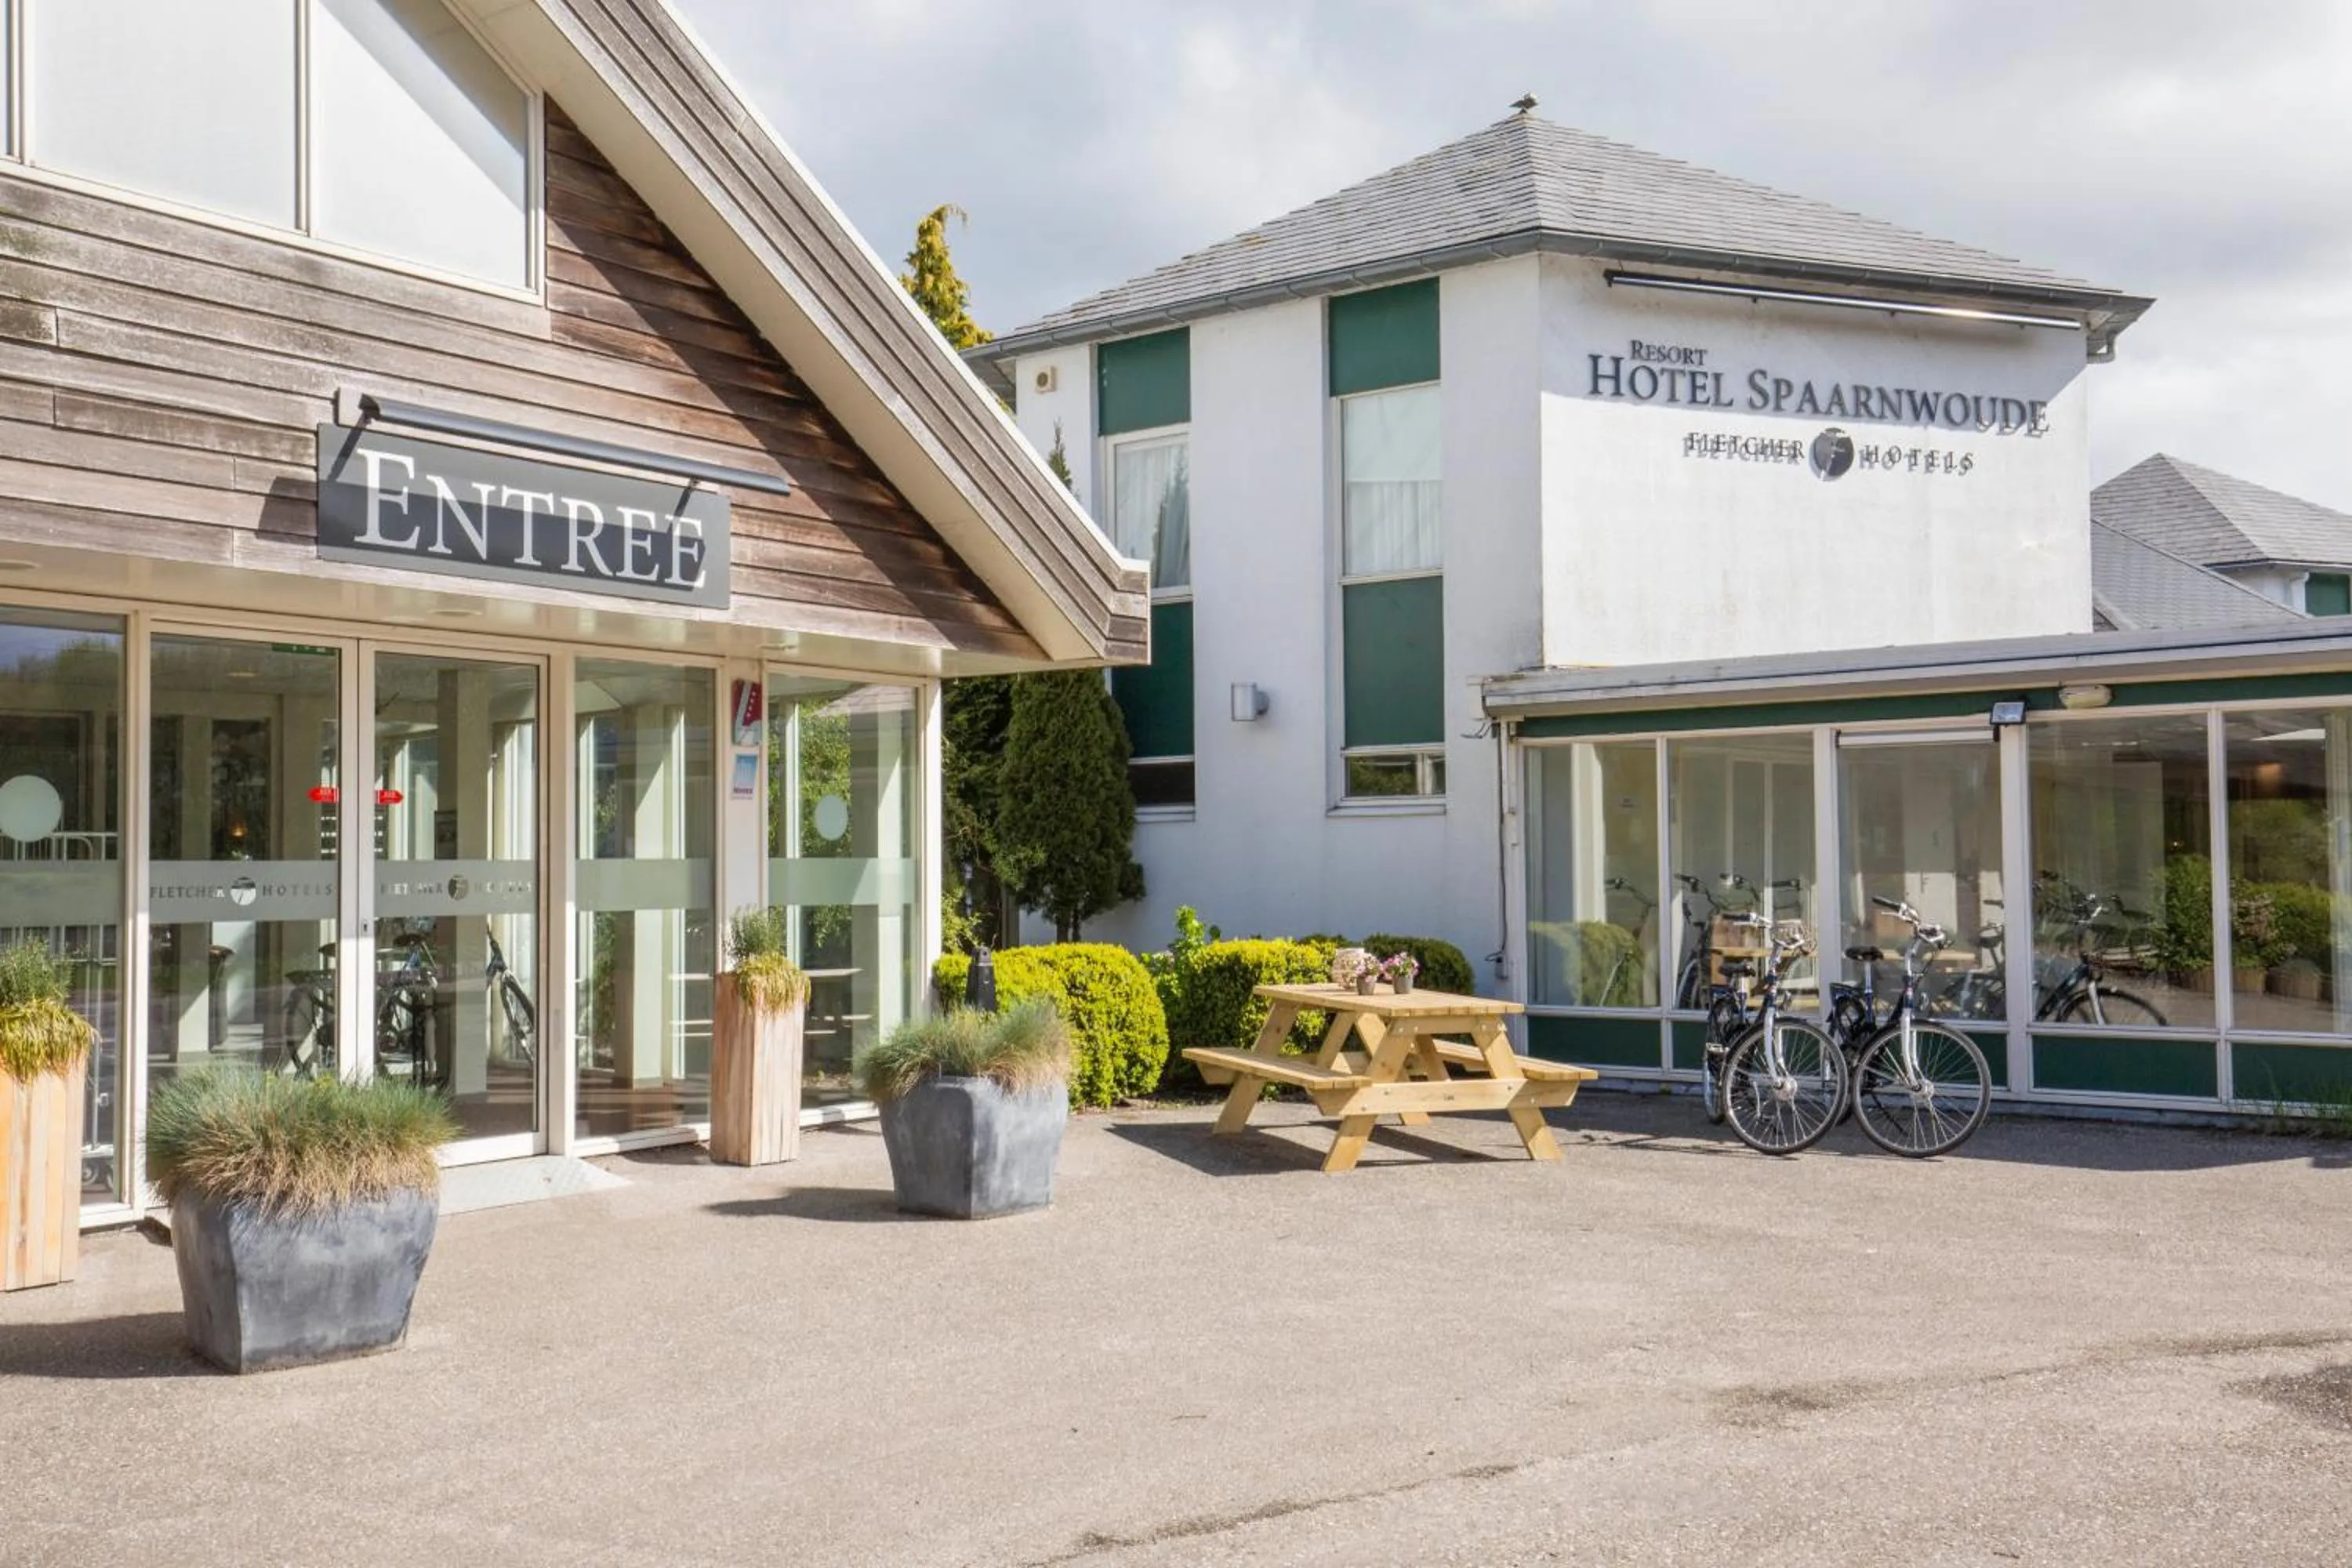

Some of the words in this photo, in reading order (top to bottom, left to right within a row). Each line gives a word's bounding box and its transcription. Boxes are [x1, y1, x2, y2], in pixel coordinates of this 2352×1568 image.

[1629, 339, 1708, 366] RESORT
[1588, 354, 1734, 407] HOTEL
[1747, 368, 2051, 433] SPAARNWOUDE
[1686, 431, 1804, 460] FLETCHER
[1861, 445, 1974, 470] HOTELS
[353, 448, 707, 589] ENTREE
[150, 884, 226, 898] FLETCHER
[262, 883, 333, 897] HOTELS
